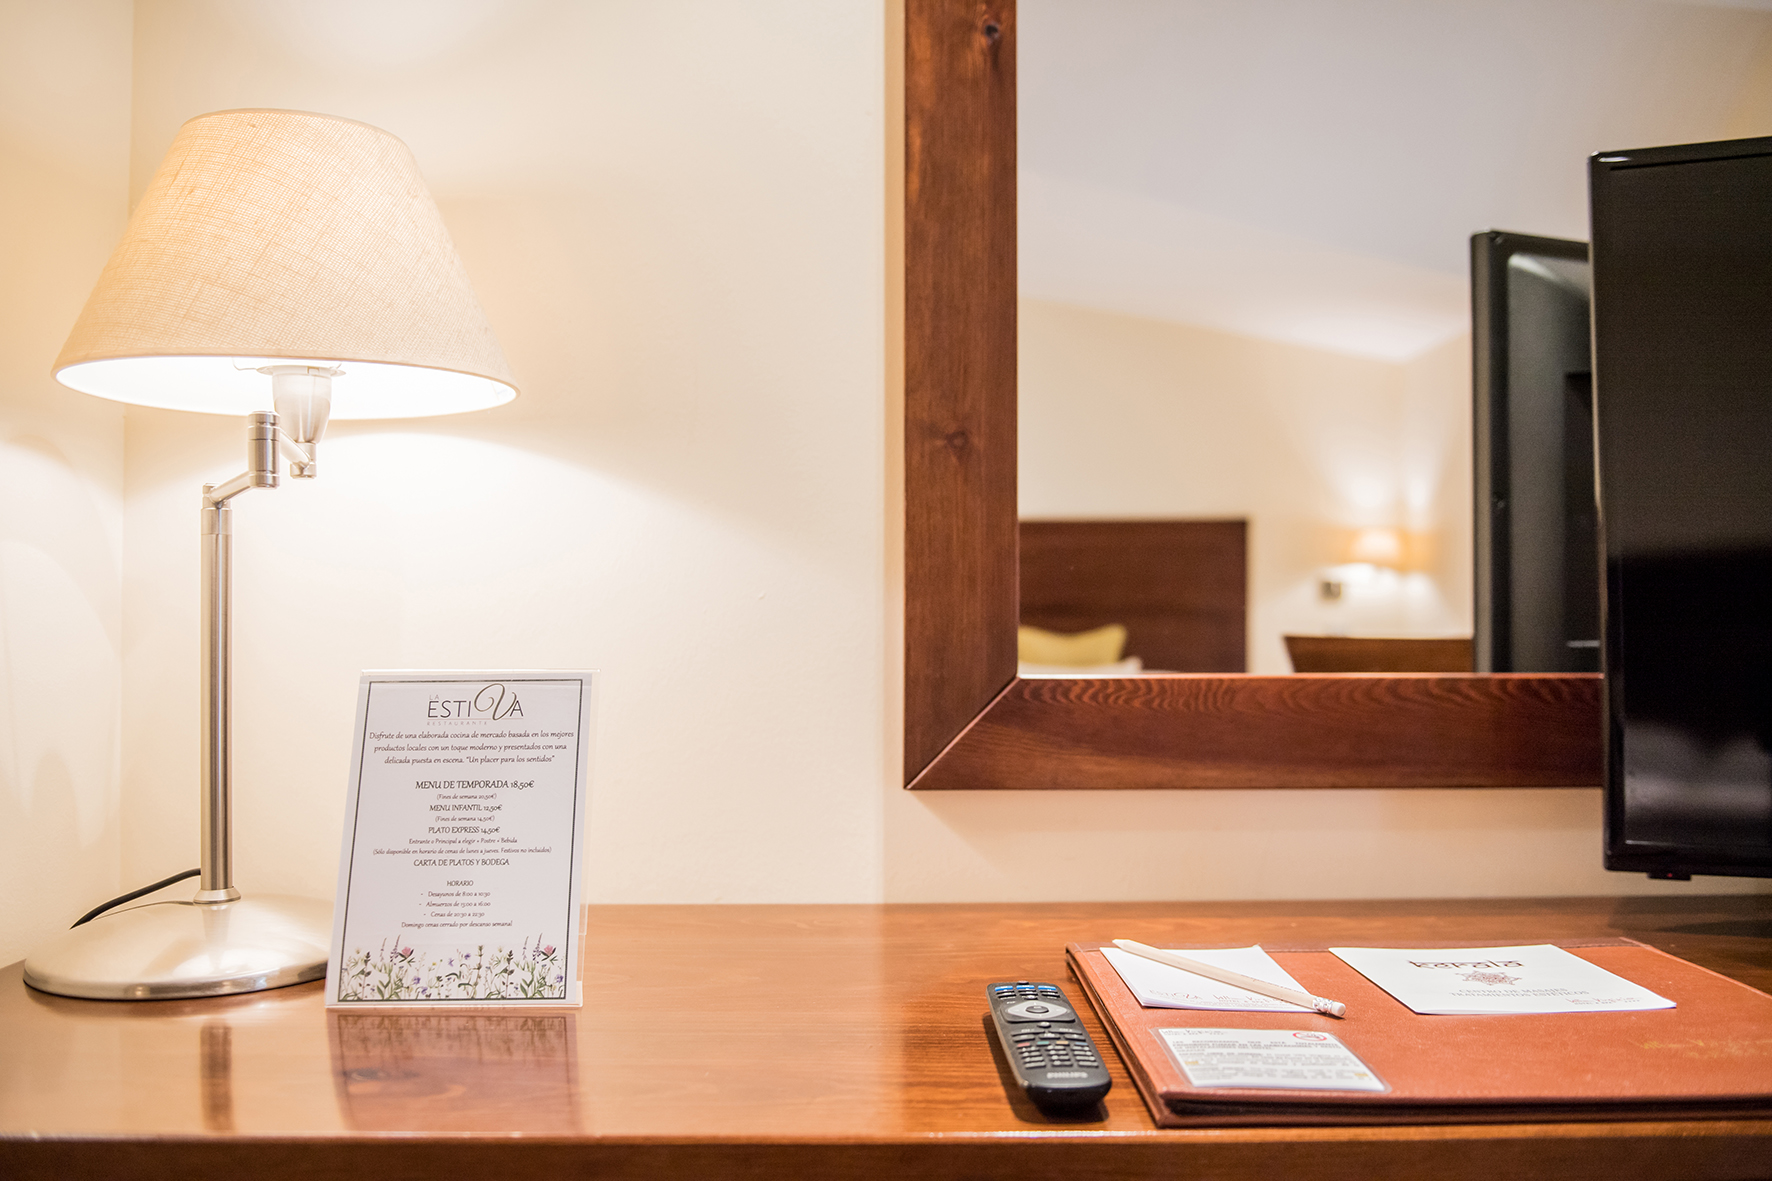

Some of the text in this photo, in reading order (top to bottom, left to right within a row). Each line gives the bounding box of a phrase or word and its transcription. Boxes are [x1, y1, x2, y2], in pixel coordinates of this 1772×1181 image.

[427, 683, 524, 721] ESTIVA
[369, 731, 394, 741] Disfrute
[396, 731, 404, 739] de
[418, 731, 449, 739] elaborada
[480, 730, 507, 738] mercado
[508, 730, 530, 738] basada
[550, 731, 574, 739] mejores
[373, 744, 405, 753] productos
[406, 743, 427, 751] locales
[451, 744, 468, 753] toque
[469, 743, 498, 751] moderno
[503, 742, 541, 752] presentados
[384, 756, 410, 764] delicada
[480, 755, 499, 765] placer
[500, 757, 515, 765] para
[516, 755, 525, 763] los
[415, 780, 535, 790] MENU DE TEMPORADA 18,50€
[429, 804, 451, 812] MENU
[428, 826, 501, 835] PLATO EXPRESS 14,50€
[386, 848, 411, 856] disponible
[413, 859, 437, 867] CARTA
[448, 858, 475, 866] PLATOS
[475, 858, 480, 866] Y
[481, 858, 510, 866] BODEGA
[428, 890, 455, 898] Desayunos
